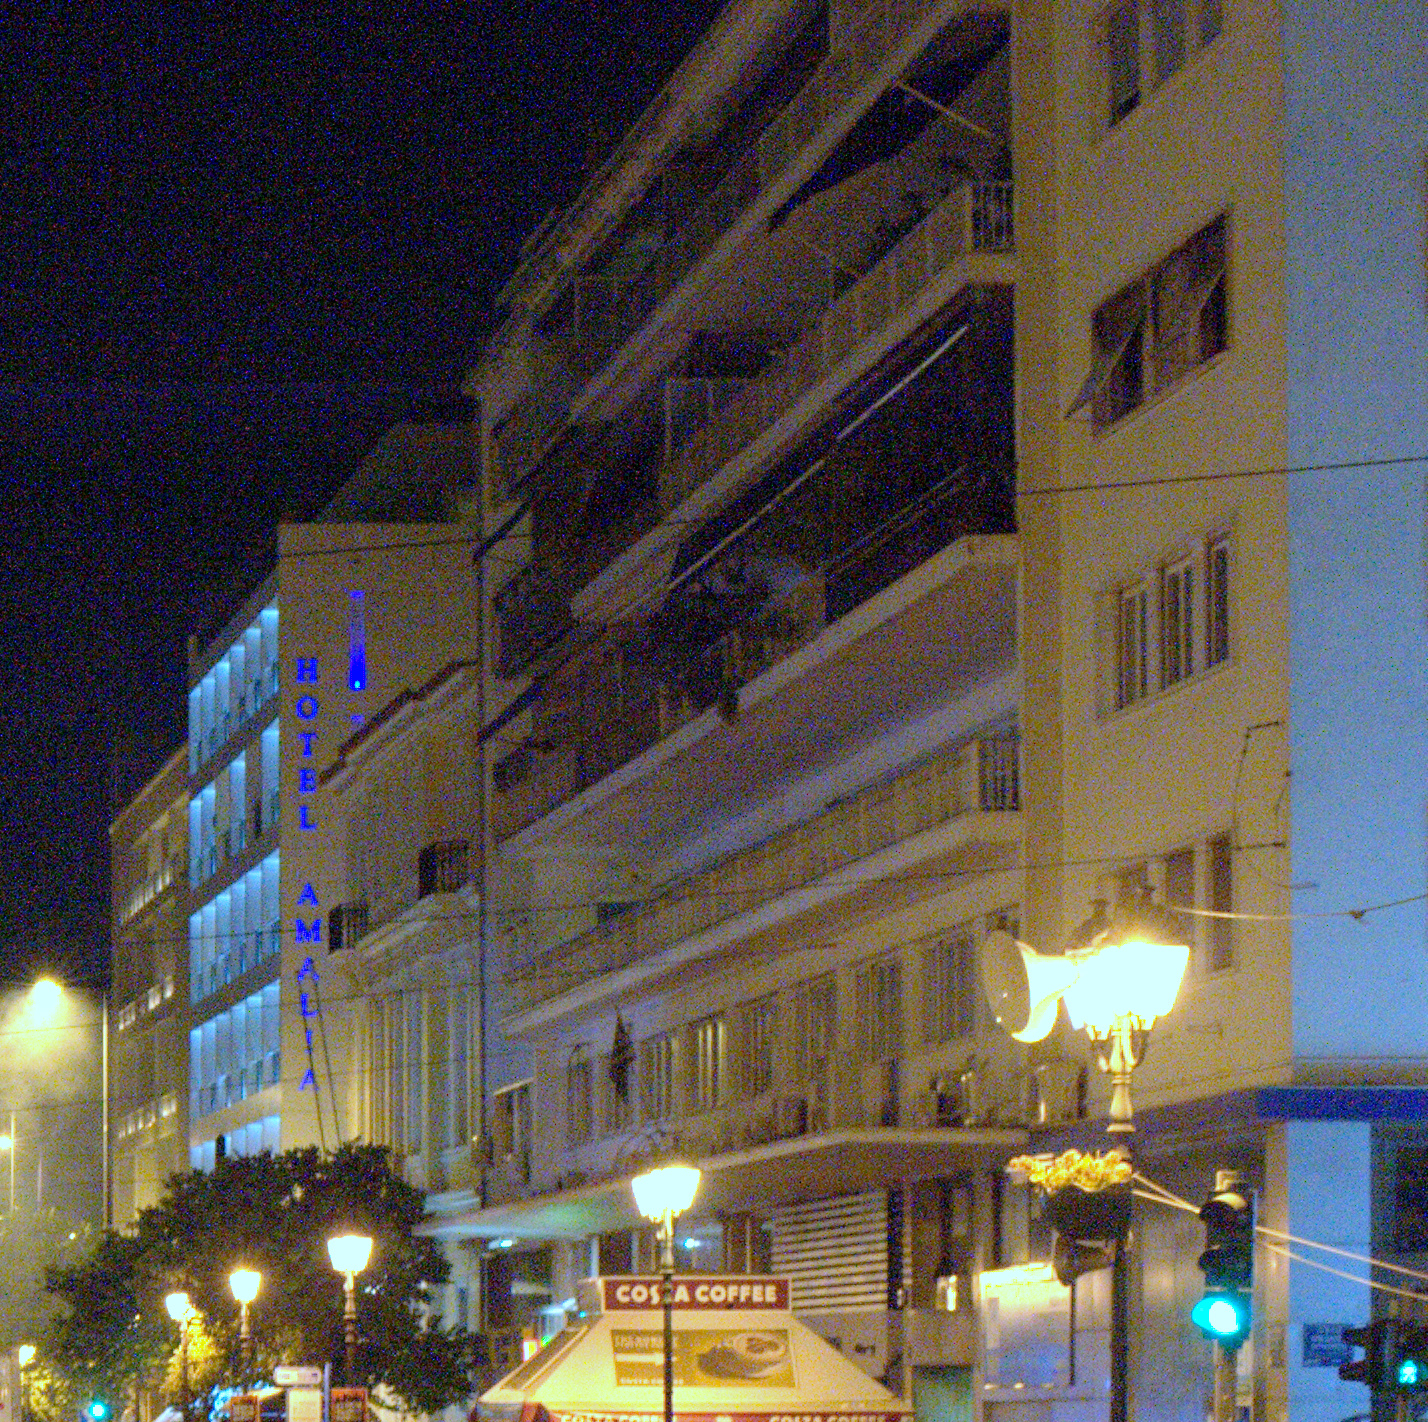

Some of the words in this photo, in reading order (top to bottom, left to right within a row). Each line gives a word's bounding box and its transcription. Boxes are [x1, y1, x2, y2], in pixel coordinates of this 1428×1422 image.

[296, 658, 318, 830] HOTEL
[295, 882, 323, 1092] AMALIA
[695, 1285, 778, 1303] COFFEE
